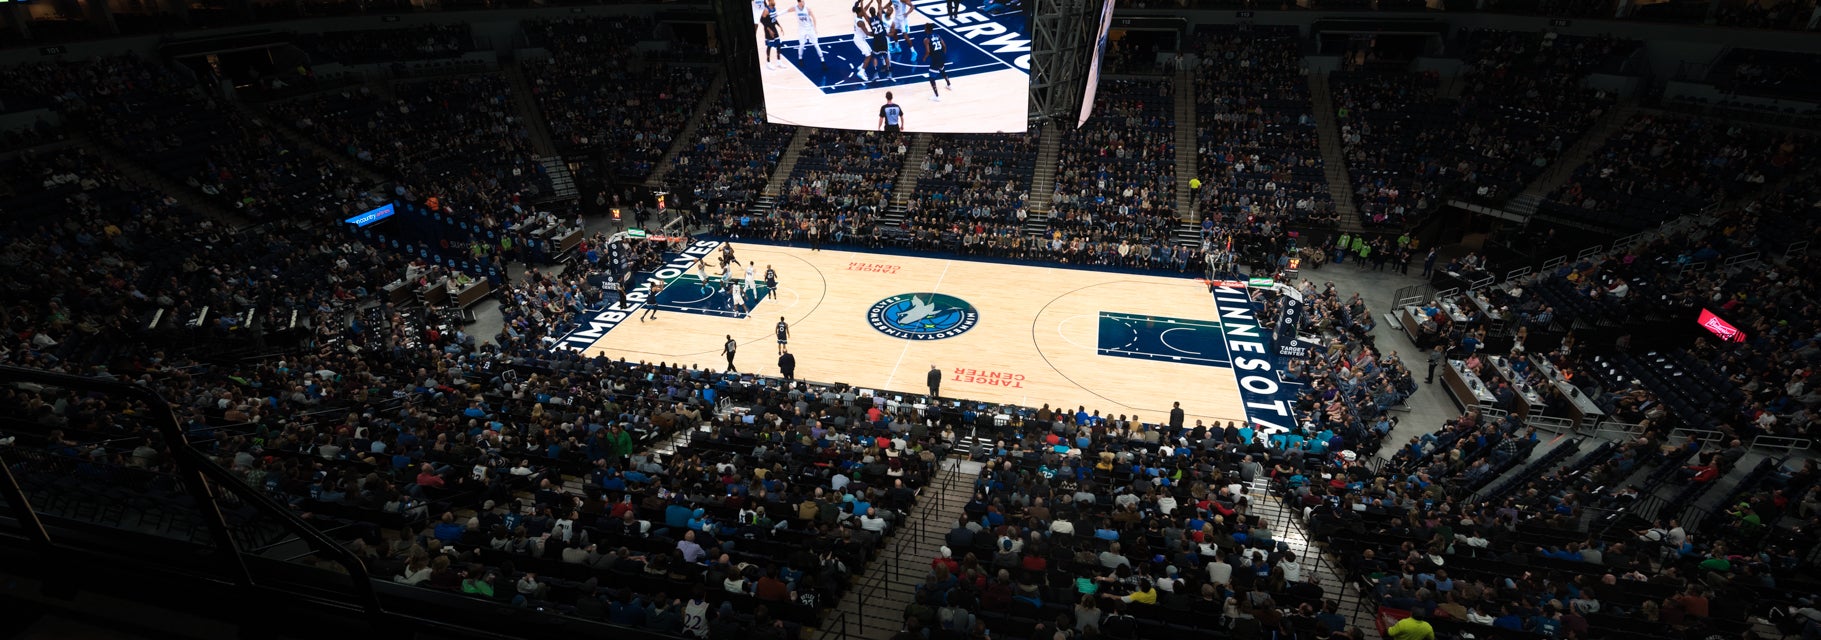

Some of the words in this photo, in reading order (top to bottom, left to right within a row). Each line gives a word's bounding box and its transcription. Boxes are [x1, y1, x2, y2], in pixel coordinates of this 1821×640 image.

[872, 24, 884, 35] 22
[932, 40, 942, 51] 23
[848, 266, 897, 274] TARGET
[849, 261, 902, 270] CENTER
[869, 296, 907, 339] TIMBERWOLVES
[917, 312, 976, 340] MINNESOTA
[954, 367, 1025, 381] CENTER
[953, 374, 1024, 389] TARGET
